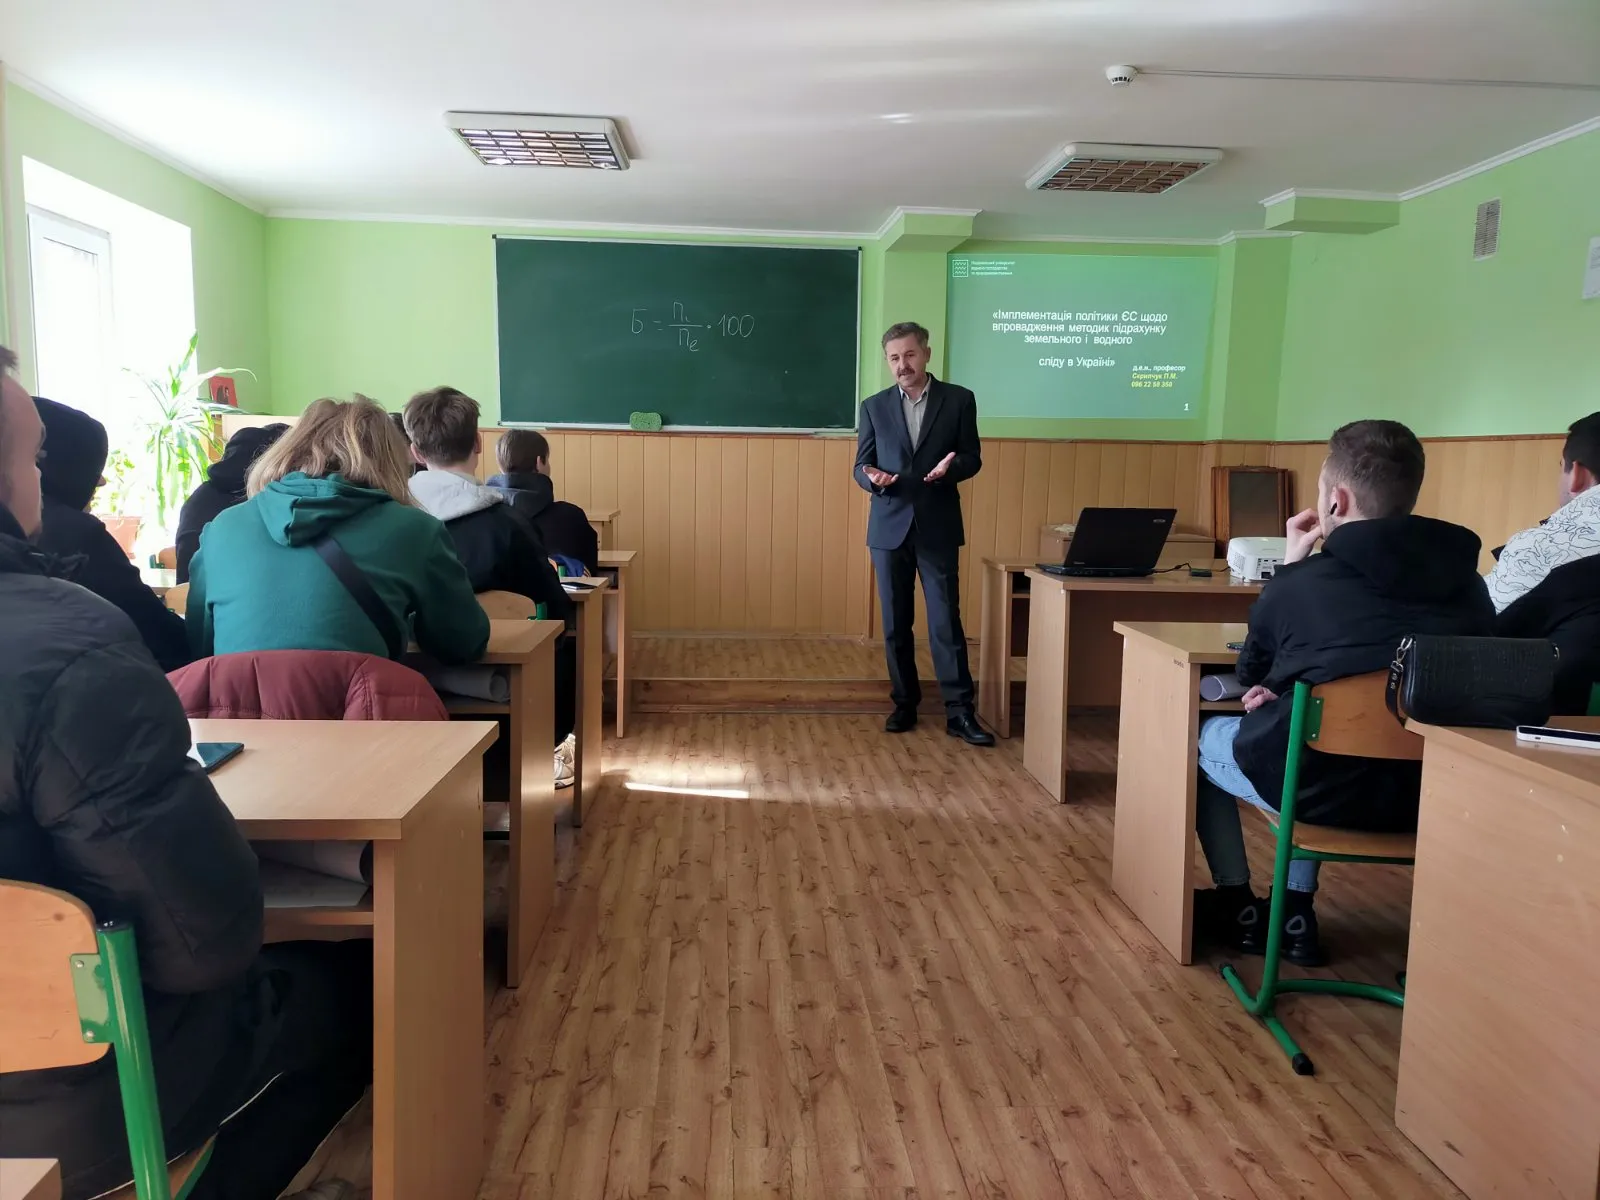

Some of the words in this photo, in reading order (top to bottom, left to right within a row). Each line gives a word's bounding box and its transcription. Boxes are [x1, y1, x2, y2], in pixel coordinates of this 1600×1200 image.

[992, 310, 1072, 321] «Імплементація
[1075, 311, 1118, 322] політики
[1121, 311, 1138, 321] ЄС
[1140, 312, 1168, 323] щодо
[718, 314, 755, 338] 100
[992, 322, 1065, 333] впровадження
[1068, 324, 1109, 334] методик
[1112, 323, 1167, 335] підрахунку
[1024, 334, 1082, 344] земельного
[1093, 335, 1133, 345] водного
[1038, 356, 1065, 368] сліду
[1067, 358, 1074, 366] в
[1076, 357, 1115, 368] Україні»
[1183, 402, 1189, 411] 1
